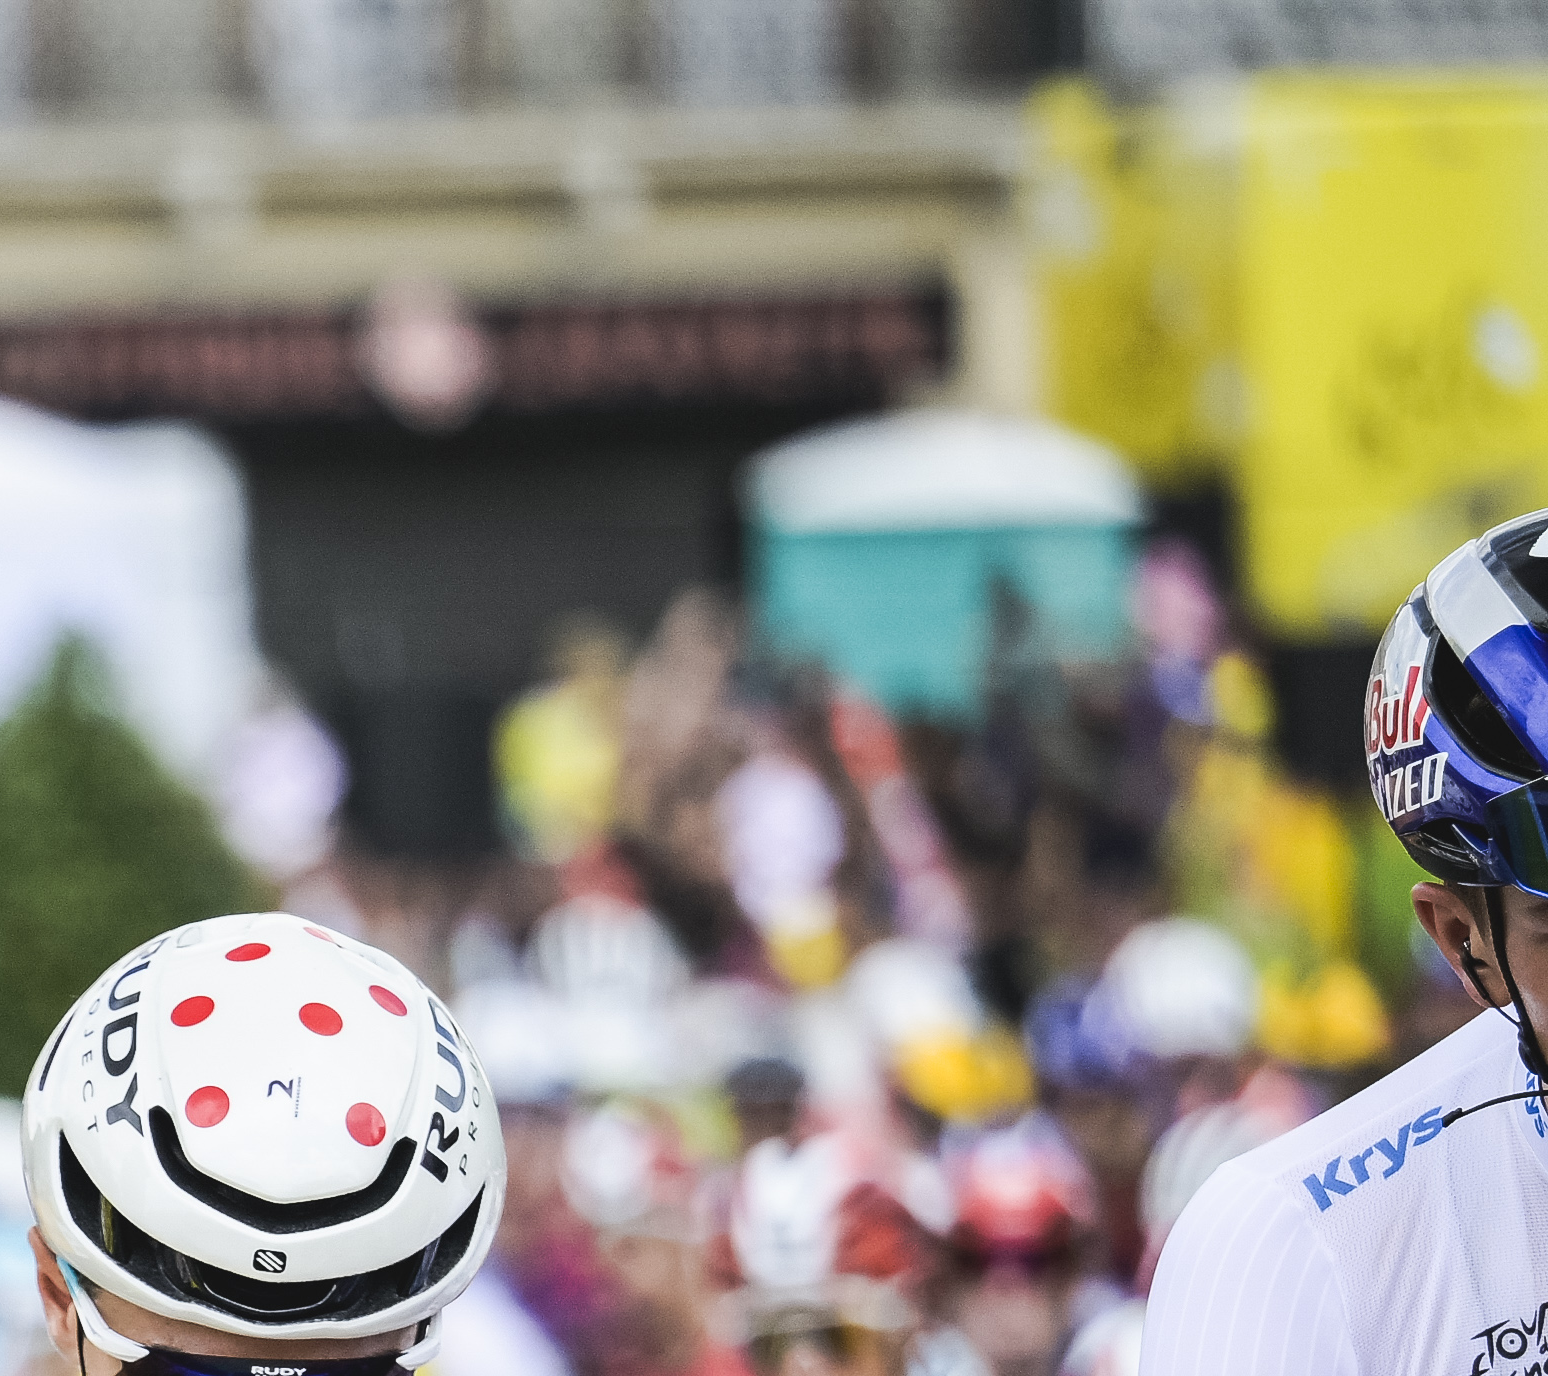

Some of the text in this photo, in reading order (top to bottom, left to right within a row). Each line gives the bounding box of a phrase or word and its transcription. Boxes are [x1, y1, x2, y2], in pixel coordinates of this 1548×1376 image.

[1368, 665, 1431, 756] Bull
[81, 998, 101, 1133] OJECT
[419, 996, 467, 1184] RUD
[1302, 1103, 1444, 1214] Krys
